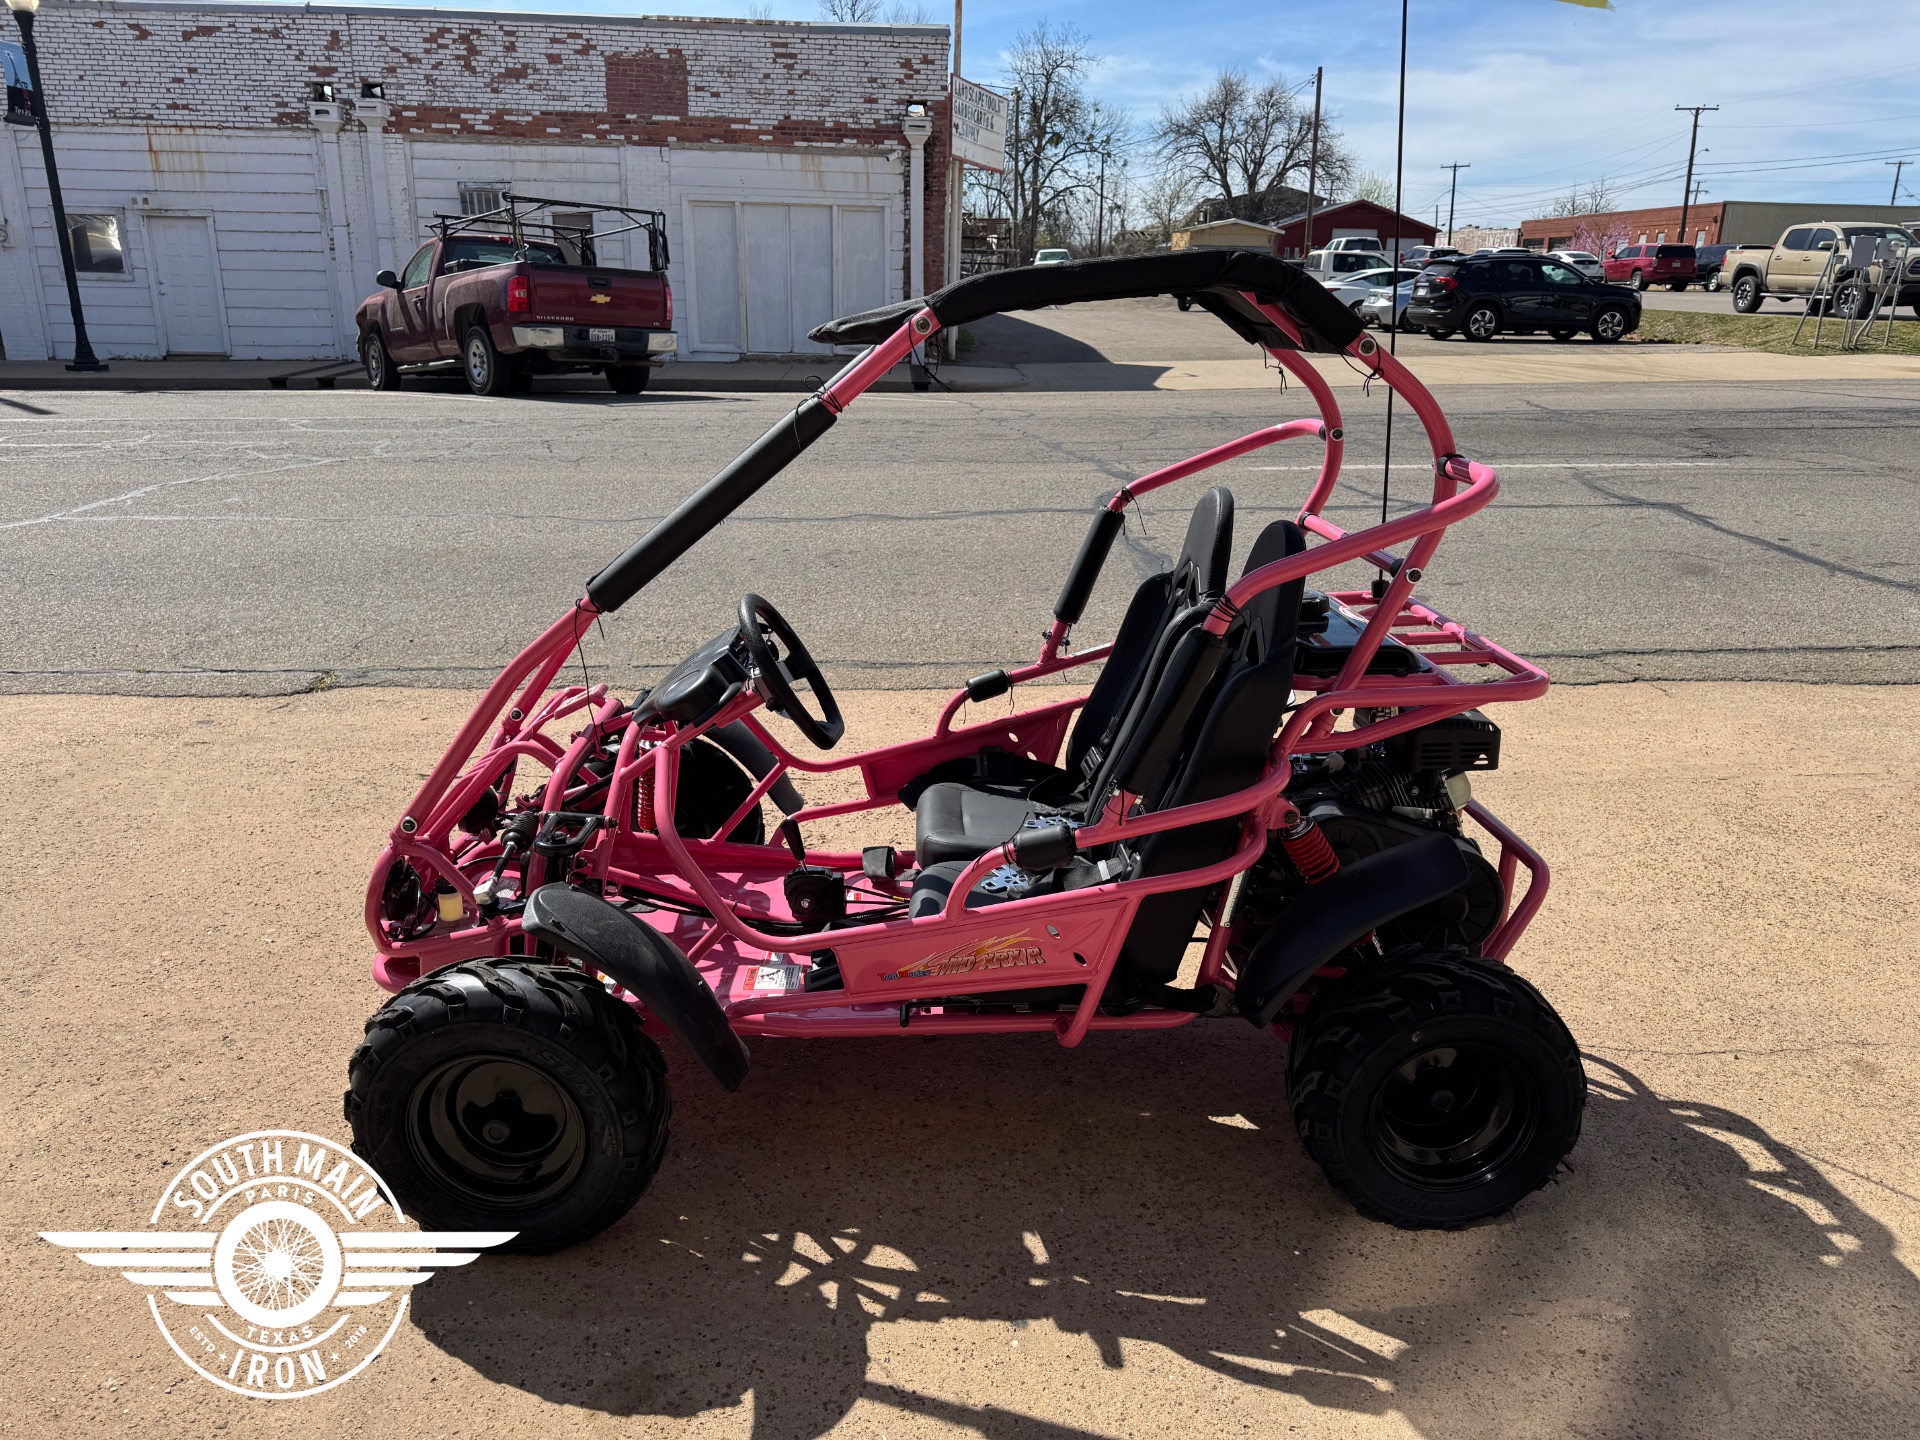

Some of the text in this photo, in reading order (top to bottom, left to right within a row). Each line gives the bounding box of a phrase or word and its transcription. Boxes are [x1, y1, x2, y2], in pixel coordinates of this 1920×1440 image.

[14, 105, 31, 116] Texas
[961, 122, 980, 142] SUPPLY
[933, 954, 977, 976] MID
